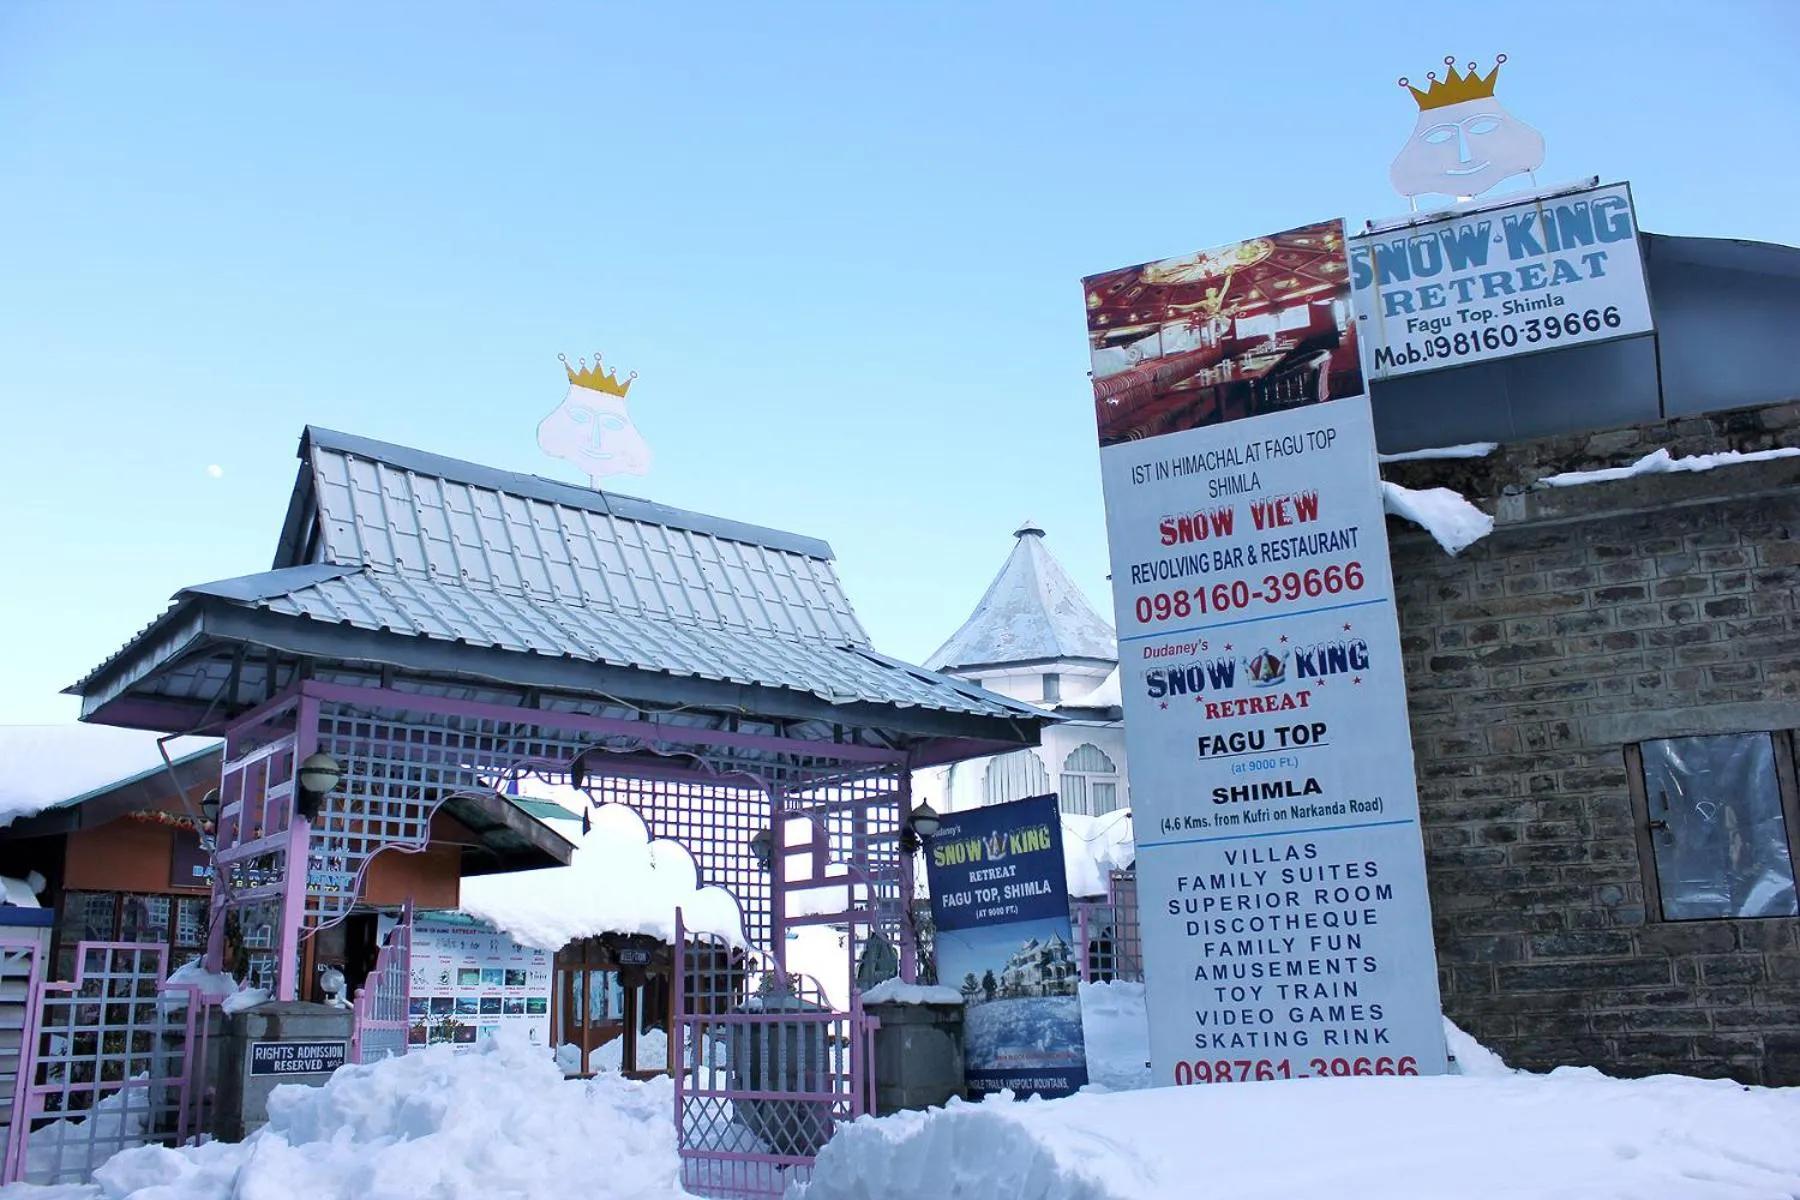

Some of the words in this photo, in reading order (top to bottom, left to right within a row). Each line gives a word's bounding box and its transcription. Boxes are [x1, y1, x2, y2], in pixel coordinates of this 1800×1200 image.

[1350, 220, 1492, 290] SNOW
[1502, 195, 1633, 261] KING
[1382, 251, 1608, 318] RETREAT
[1407, 316, 1451, 334] Fagu
[1503, 293, 1565, 316] Shimla
[1155, 461, 1169, 481] IN
[1173, 447, 1243, 477] HIMACHAL
[1245, 442, 1261, 461] AT
[1265, 436, 1304, 460] FAGU
[1306, 428, 1337, 451] TOP
[1208, 472, 1261, 499] SHIMLA
[1159, 504, 1234, 547] SNOW
[1250, 488, 1319, 531] VIEW
[1131, 553, 1210, 585] REVOLVING
[1213, 544, 1244, 570] BAR
[1247, 544, 1257, 566] &
[1262, 527, 1358, 563] RESTAURANT
[1135, 561, 1365, 624] 098160-39666
[1143, 638, 1209, 660] Dudaney's
[1144, 656, 1236, 699] SNOW
[1295, 638, 1370, 679] KING
[1205, 690, 1312, 720] RETREAT
[1198, 729, 1265, 757] FAGU
[1274, 722, 1327, 747] TOP
[1231, 762, 1246, 776] (at
[1249, 758, 1276, 773] 9000
[1279, 755, 1299, 769] Ft.)
[1212, 777, 1323, 805] SHIMLA
[1160, 817, 1181, 835] (4.6
[1184, 813, 1212, 830] Kms.
[1214, 811, 1240, 827] from
[1242, 807, 1270, 823] Kufri
[1273, 808, 1288, 821] on
[1290, 801, 1346, 820] Narkanda
[1349, 796, 1385, 815] Road)
[933, 837, 982, 867] SNOW
[1010, 825, 1051, 856] KING
[1224, 843, 1318, 866] VILLAS
[969, 865, 1017, 883] RETREAT
[1177, 870, 1268, 892] FAMILY
[1281, 861, 1379, 884] SUITES
[942, 891, 972, 908] FAGU
[975, 888, 1001, 904] TOP,
[1004, 879, 1052, 900] SHIMLA
[1168, 891, 1301, 915] SUPERIOR
[1314, 884, 1394, 905] ROOM
[1186, 908, 1378, 936] DISCOTHEQUE
[1204, 937, 1296, 958] FAMILY
[1311, 933, 1362, 951] FUN
[1194, 956, 1378, 981] AMUSEMENTS
[1214, 986, 1263, 1003] TOY
[1277, 981, 1359, 1000] TRAIN
[1195, 1008, 1275, 1026] VIDEO
[1288, 1004, 1384, 1024] GAMES
[255, 1047, 295, 1060] RIGHTS
[297, 1046, 343, 1059] ADMISSION
[1194, 1030, 1309, 1049] SKATING
[1324, 1028, 1391, 1046] RINK
[274, 1059, 323, 1071] RESERVED
